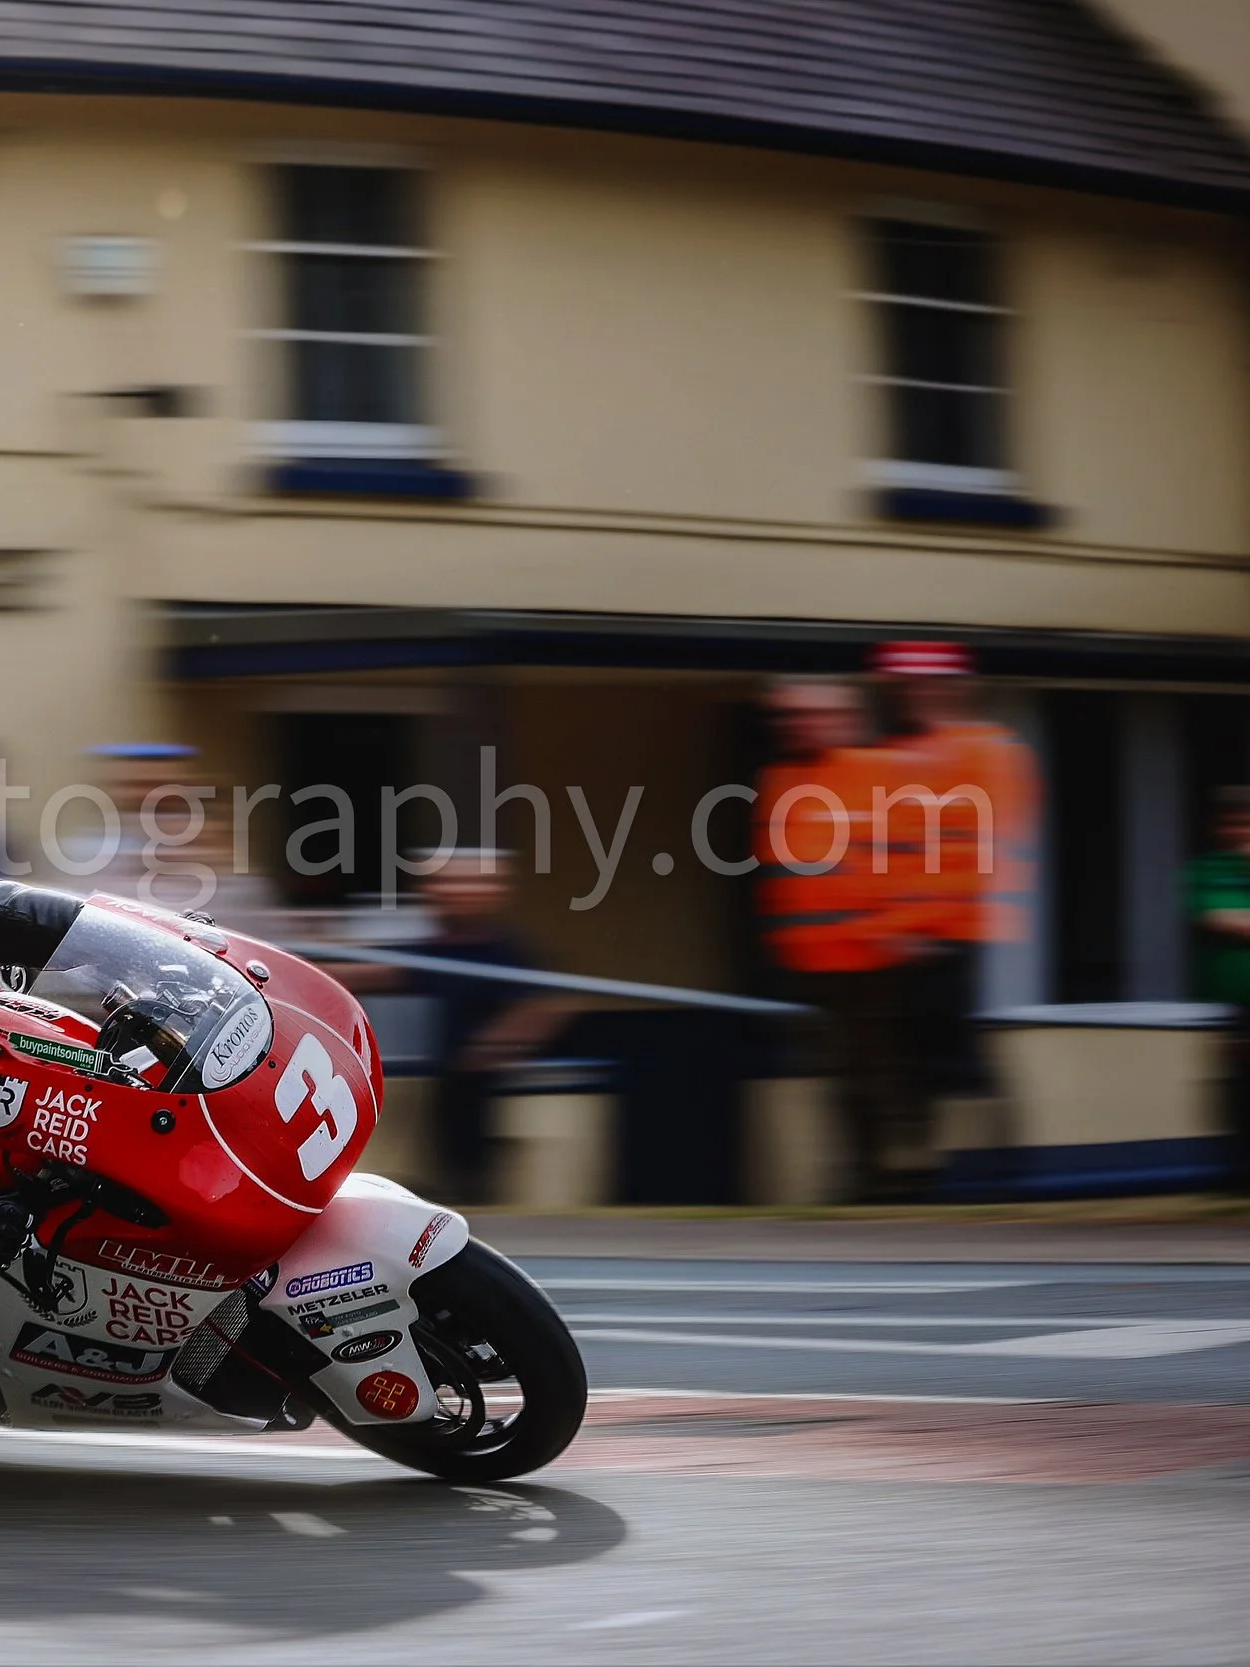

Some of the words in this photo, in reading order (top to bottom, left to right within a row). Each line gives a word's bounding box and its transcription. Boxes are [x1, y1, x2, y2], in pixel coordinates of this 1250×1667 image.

[19, 1036, 95, 1065] buypaintsonline
[210, 1005, 259, 1068] Kronos
[35, 1086, 102, 1122] JACK
[275, 1032, 358, 1182] 3
[33, 1108, 90, 1142] REID
[26, 1131, 88, 1166] CARS
[101, 1277, 194, 1312] JACK
[301, 1264, 371, 1293] ROBOTICS
[109, 1299, 190, 1328] REID
[288, 1284, 389, 1316] METZELER
[23, 1330, 165, 1374] A&J
